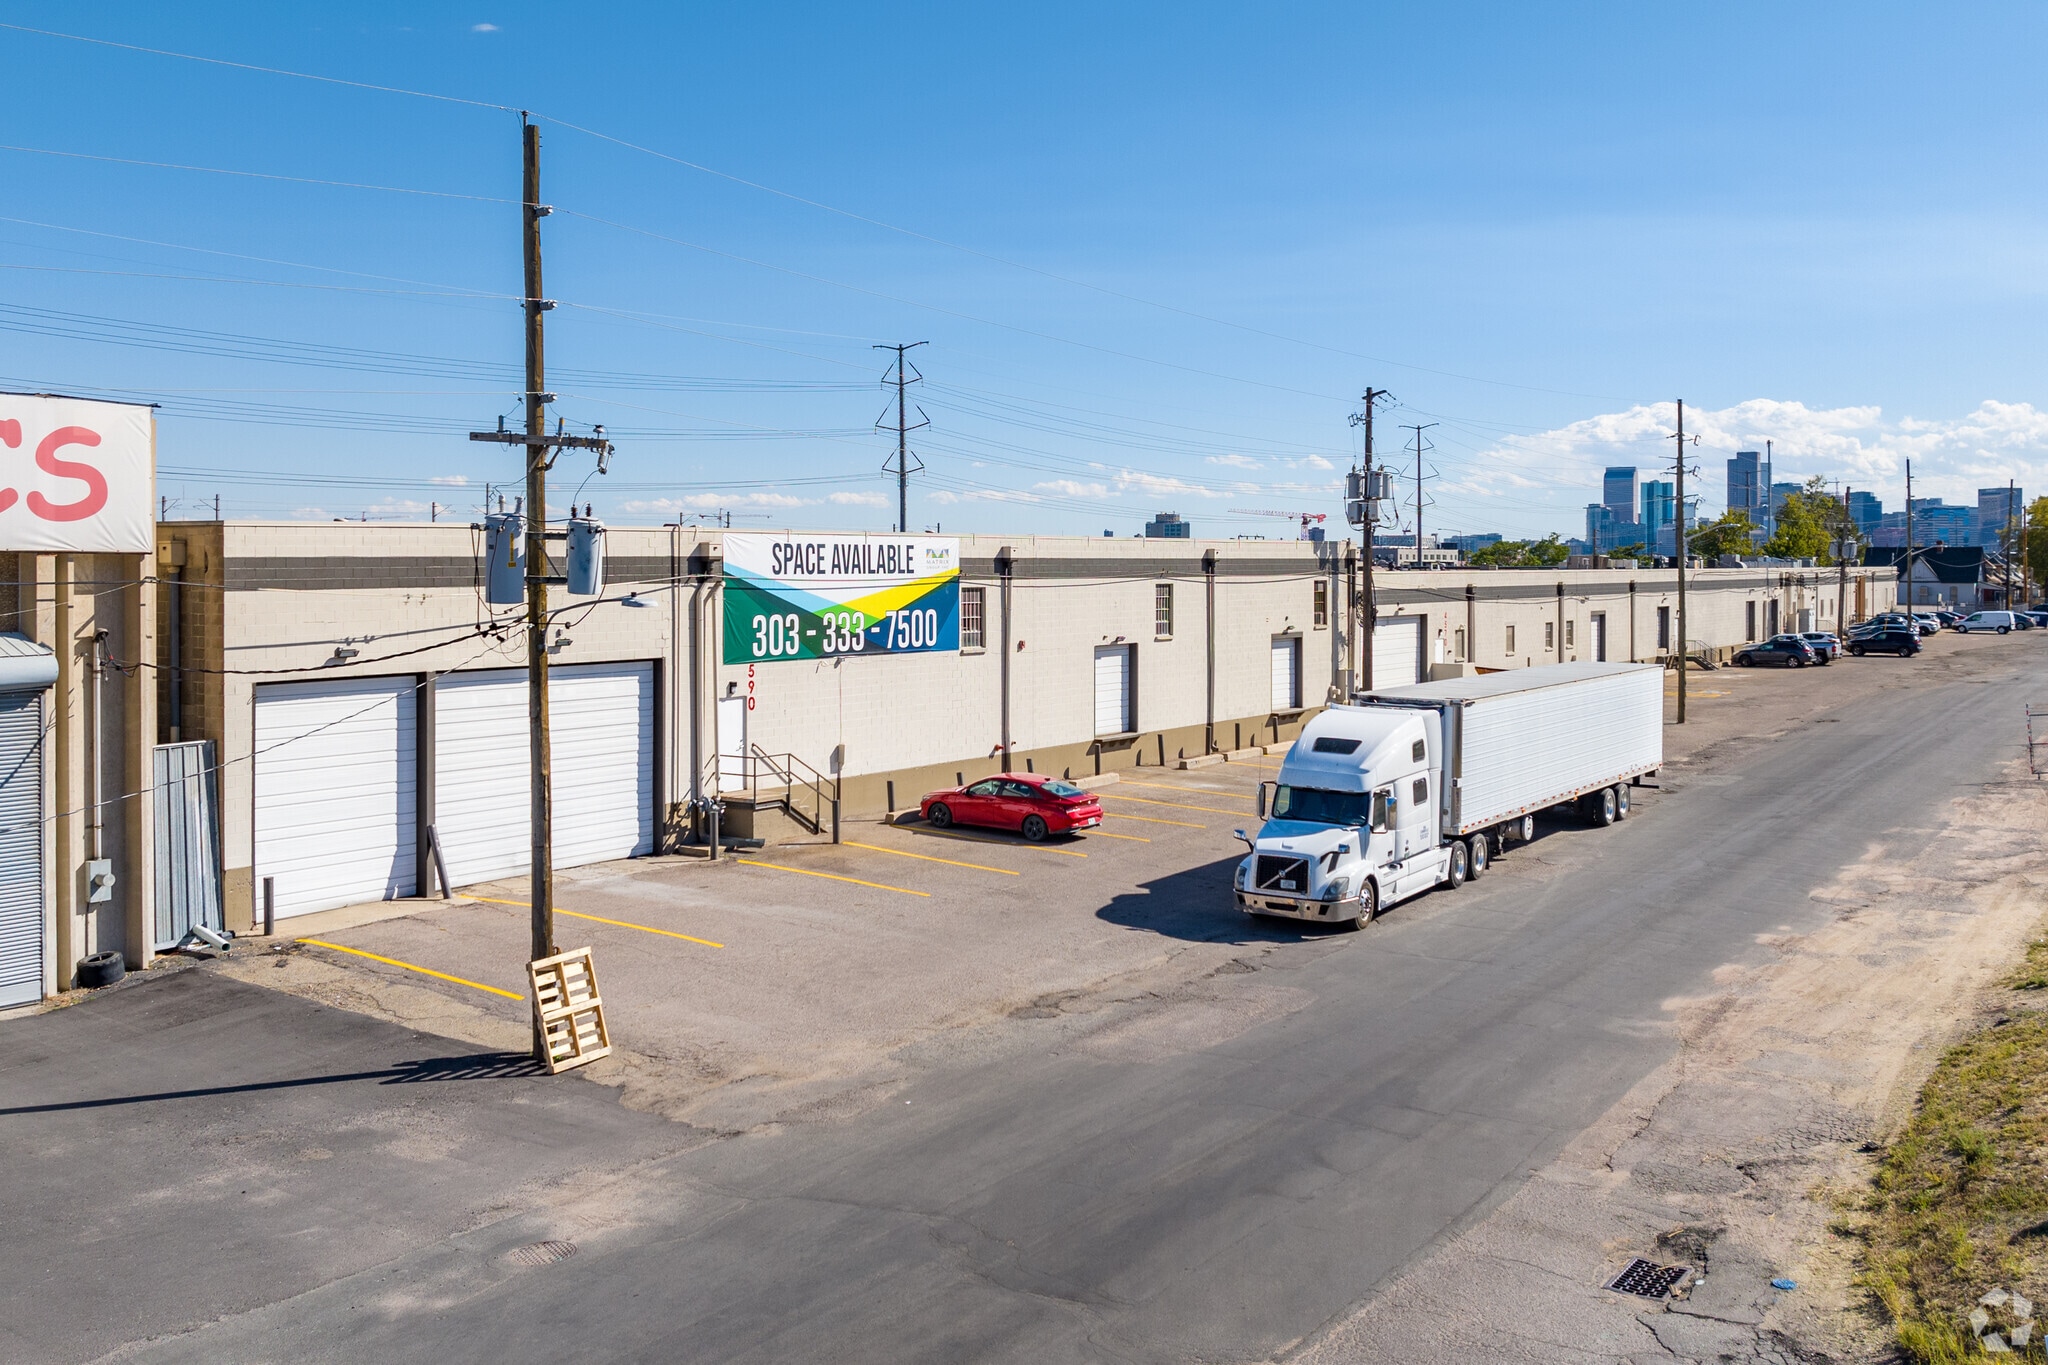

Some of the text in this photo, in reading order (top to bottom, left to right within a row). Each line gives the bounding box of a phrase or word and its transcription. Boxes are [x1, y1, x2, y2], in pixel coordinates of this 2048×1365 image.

[0, 418, 108, 522] S
[772, 542, 915, 575] SPACE AVAILABLE
[752, 613, 800, 657] 303
[822, 611, 865, 653] 333
[885, 608, 938, 649] 7500
